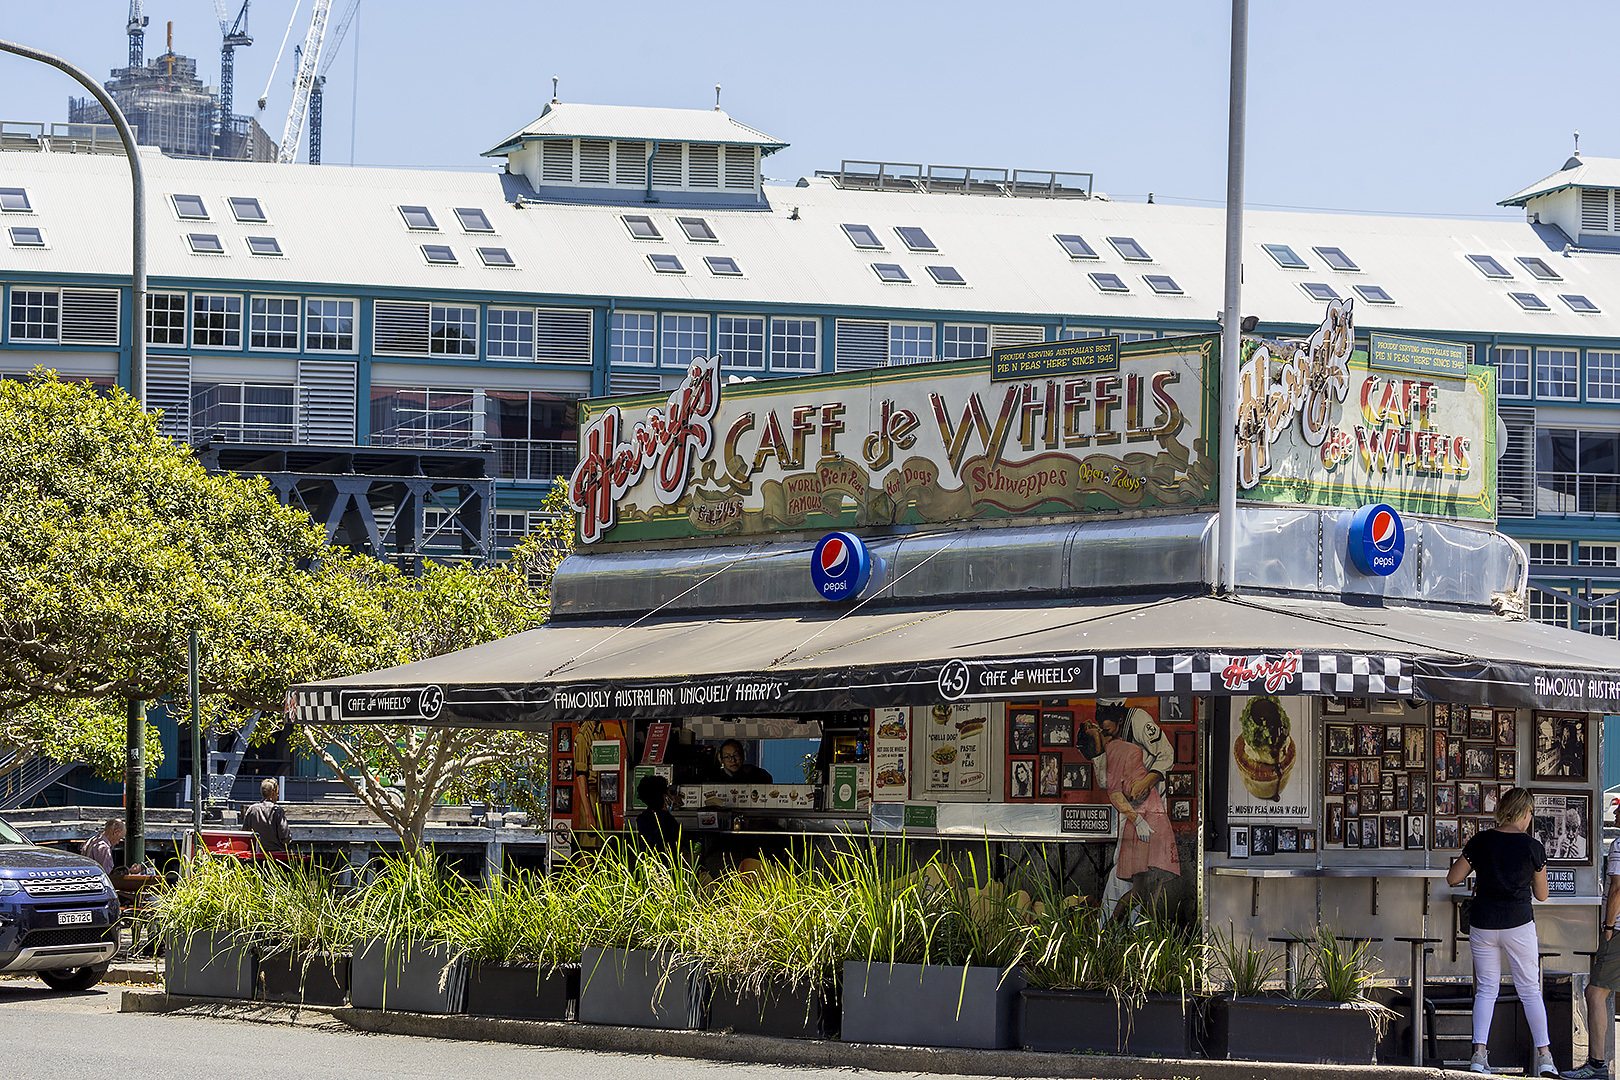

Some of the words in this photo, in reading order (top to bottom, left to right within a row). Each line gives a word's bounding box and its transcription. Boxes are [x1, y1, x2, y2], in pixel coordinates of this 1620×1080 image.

[1000, 352, 1026, 362] PROUDLY
[1028, 350, 1054, 359] SERVING
[1056, 346, 1094, 356] AUSTRALIA'S
[1096, 344, 1112, 352] BEST
[1376, 351, 1386, 360] PIE
[1394, 353, 1410, 363] PEAS
[1433, 358, 1450, 368] SINCE
[1378, 342, 1398, 350] PROUDLY
[1398, 344, 1419, 353] SERVING
[1450, 350, 1462, 358] BEST
[998, 364, 1010, 373] PIE
[1012, 362, 1018, 372] N
[1020, 361, 1040, 371] PEAS
[1043, 358, 1070, 368] "HERE"
[1072, 356, 1094, 366] SINCE
[1097, 354, 1114, 364] 1945
[1360, 374, 1439, 430] CAFE
[570, 355, 720, 543] Harry's
[723, 401, 846, 496] CAFE
[862, 398, 921, 471] de
[928, 370, 1181, 478] WHEELS
[1354, 424, 1472, 481] WHEELS
[886, 479, 900, 496] Hot
[904, 468, 932, 486] Dogs
[972, 465, 1068, 499] Schweppes
[1079, 464, 1104, 483] Open
[788, 478, 822, 494] WORLD
[1374, 556, 1394, 568] pepsi
[823, 580, 847, 593] pepsi
[942, 668, 964, 692] 45
[980, 670, 1008, 686] CAFE
[1534, 676, 1584, 697] FAMOUSLY
[348, 698, 366, 711] CAFE
[422, 690, 441, 712] 45
[554, 690, 611, 710] FAMOUSLY
[614, 688, 677, 708] AUSTRALIAN.
[680, 684, 732, 704] UNIQUELY
[1066, 810, 1080, 819] CCTV
[1080, 810, 1086, 819] IN
[1087, 810, 1098, 819] USE
[1099, 810, 1107, 819] ON
[1064, 820, 1080, 829] THESE
[1081, 820, 1108, 830] PREMISES
